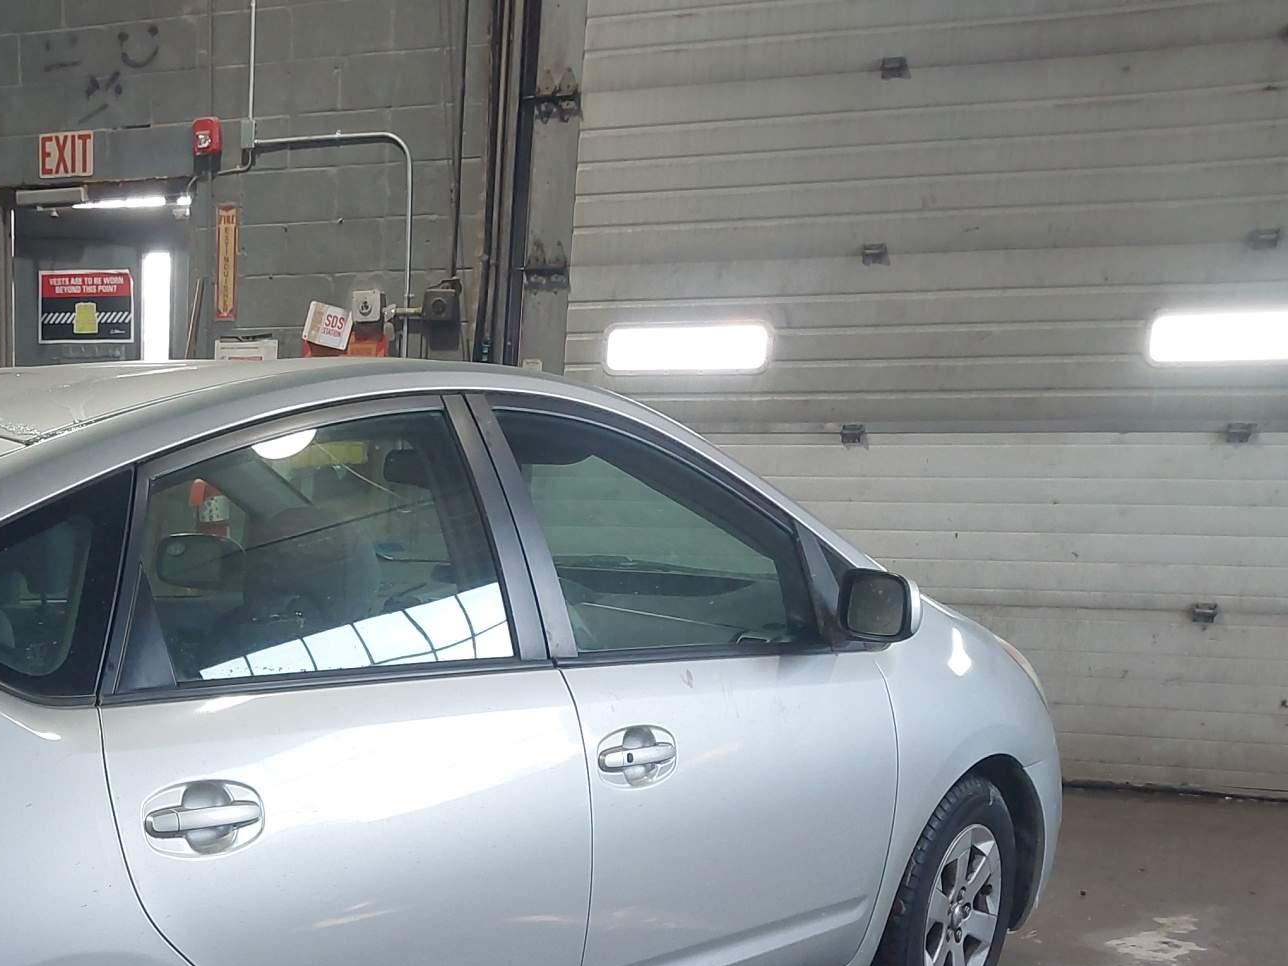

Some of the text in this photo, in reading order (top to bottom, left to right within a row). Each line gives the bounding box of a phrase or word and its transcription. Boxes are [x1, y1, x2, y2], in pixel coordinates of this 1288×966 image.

[41, 134, 91, 175] EXIT
[49, 278, 69, 286] VESTS
[70, 277, 82, 285] ARE
[84, 277, 92, 285] TO
[103, 276, 124, 284] WORN
[55, 285, 117, 294] BEYOND THIS POINT
[324, 314, 345, 330] SDS
[322, 327, 342, 337] STATION
